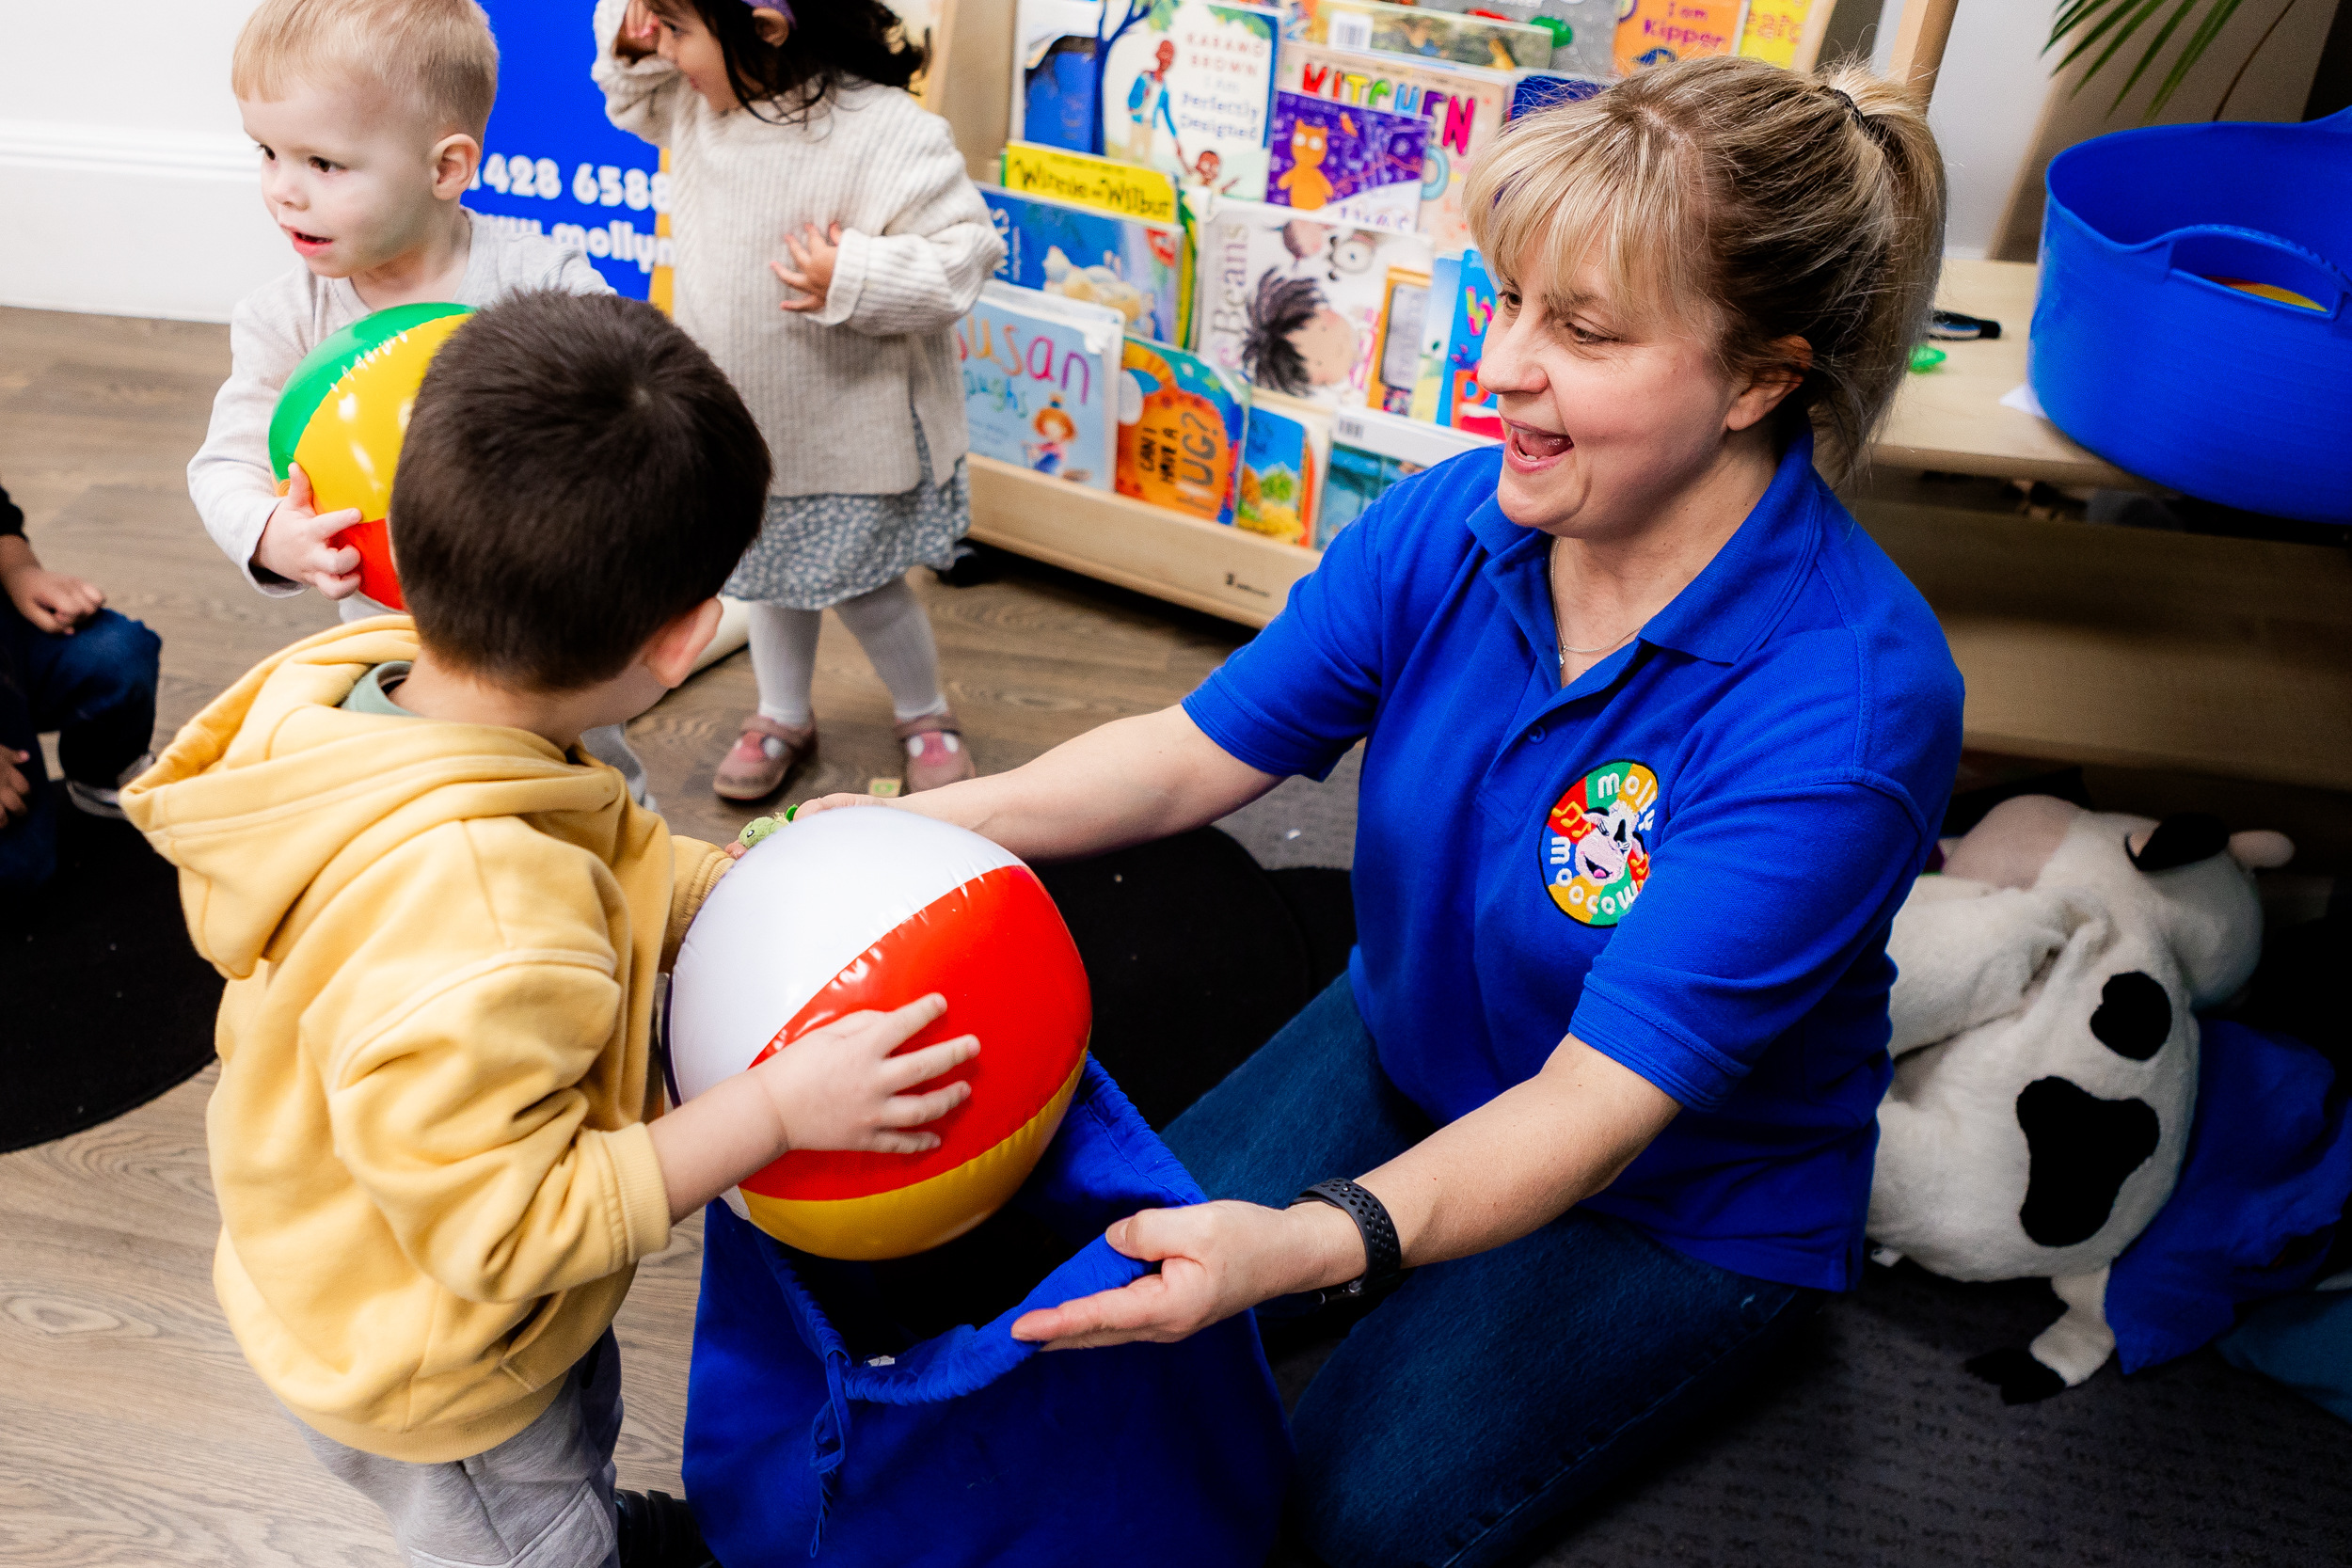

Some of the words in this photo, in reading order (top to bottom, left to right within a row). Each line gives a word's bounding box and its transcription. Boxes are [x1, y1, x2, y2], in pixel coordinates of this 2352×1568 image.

[1680, 7, 1708, 22] am
[1185, 32, 1265, 57] KARAMO
[1644, 19, 1725, 47] Kipper
[1190, 54, 1259, 76] BROWN
[1181, 91, 1259, 124] Perfectly
[1180, 114, 1258, 139] Designed
[1013, 159, 1087, 198] Winnie
[1101, 179, 1170, 216] Wilbur
[1212, 223, 1248, 335] Beans
[1163, 427, 1178, 440] A
[1139, 436, 1157, 472] CAN
[1175, 412, 1219, 513] HUG?
